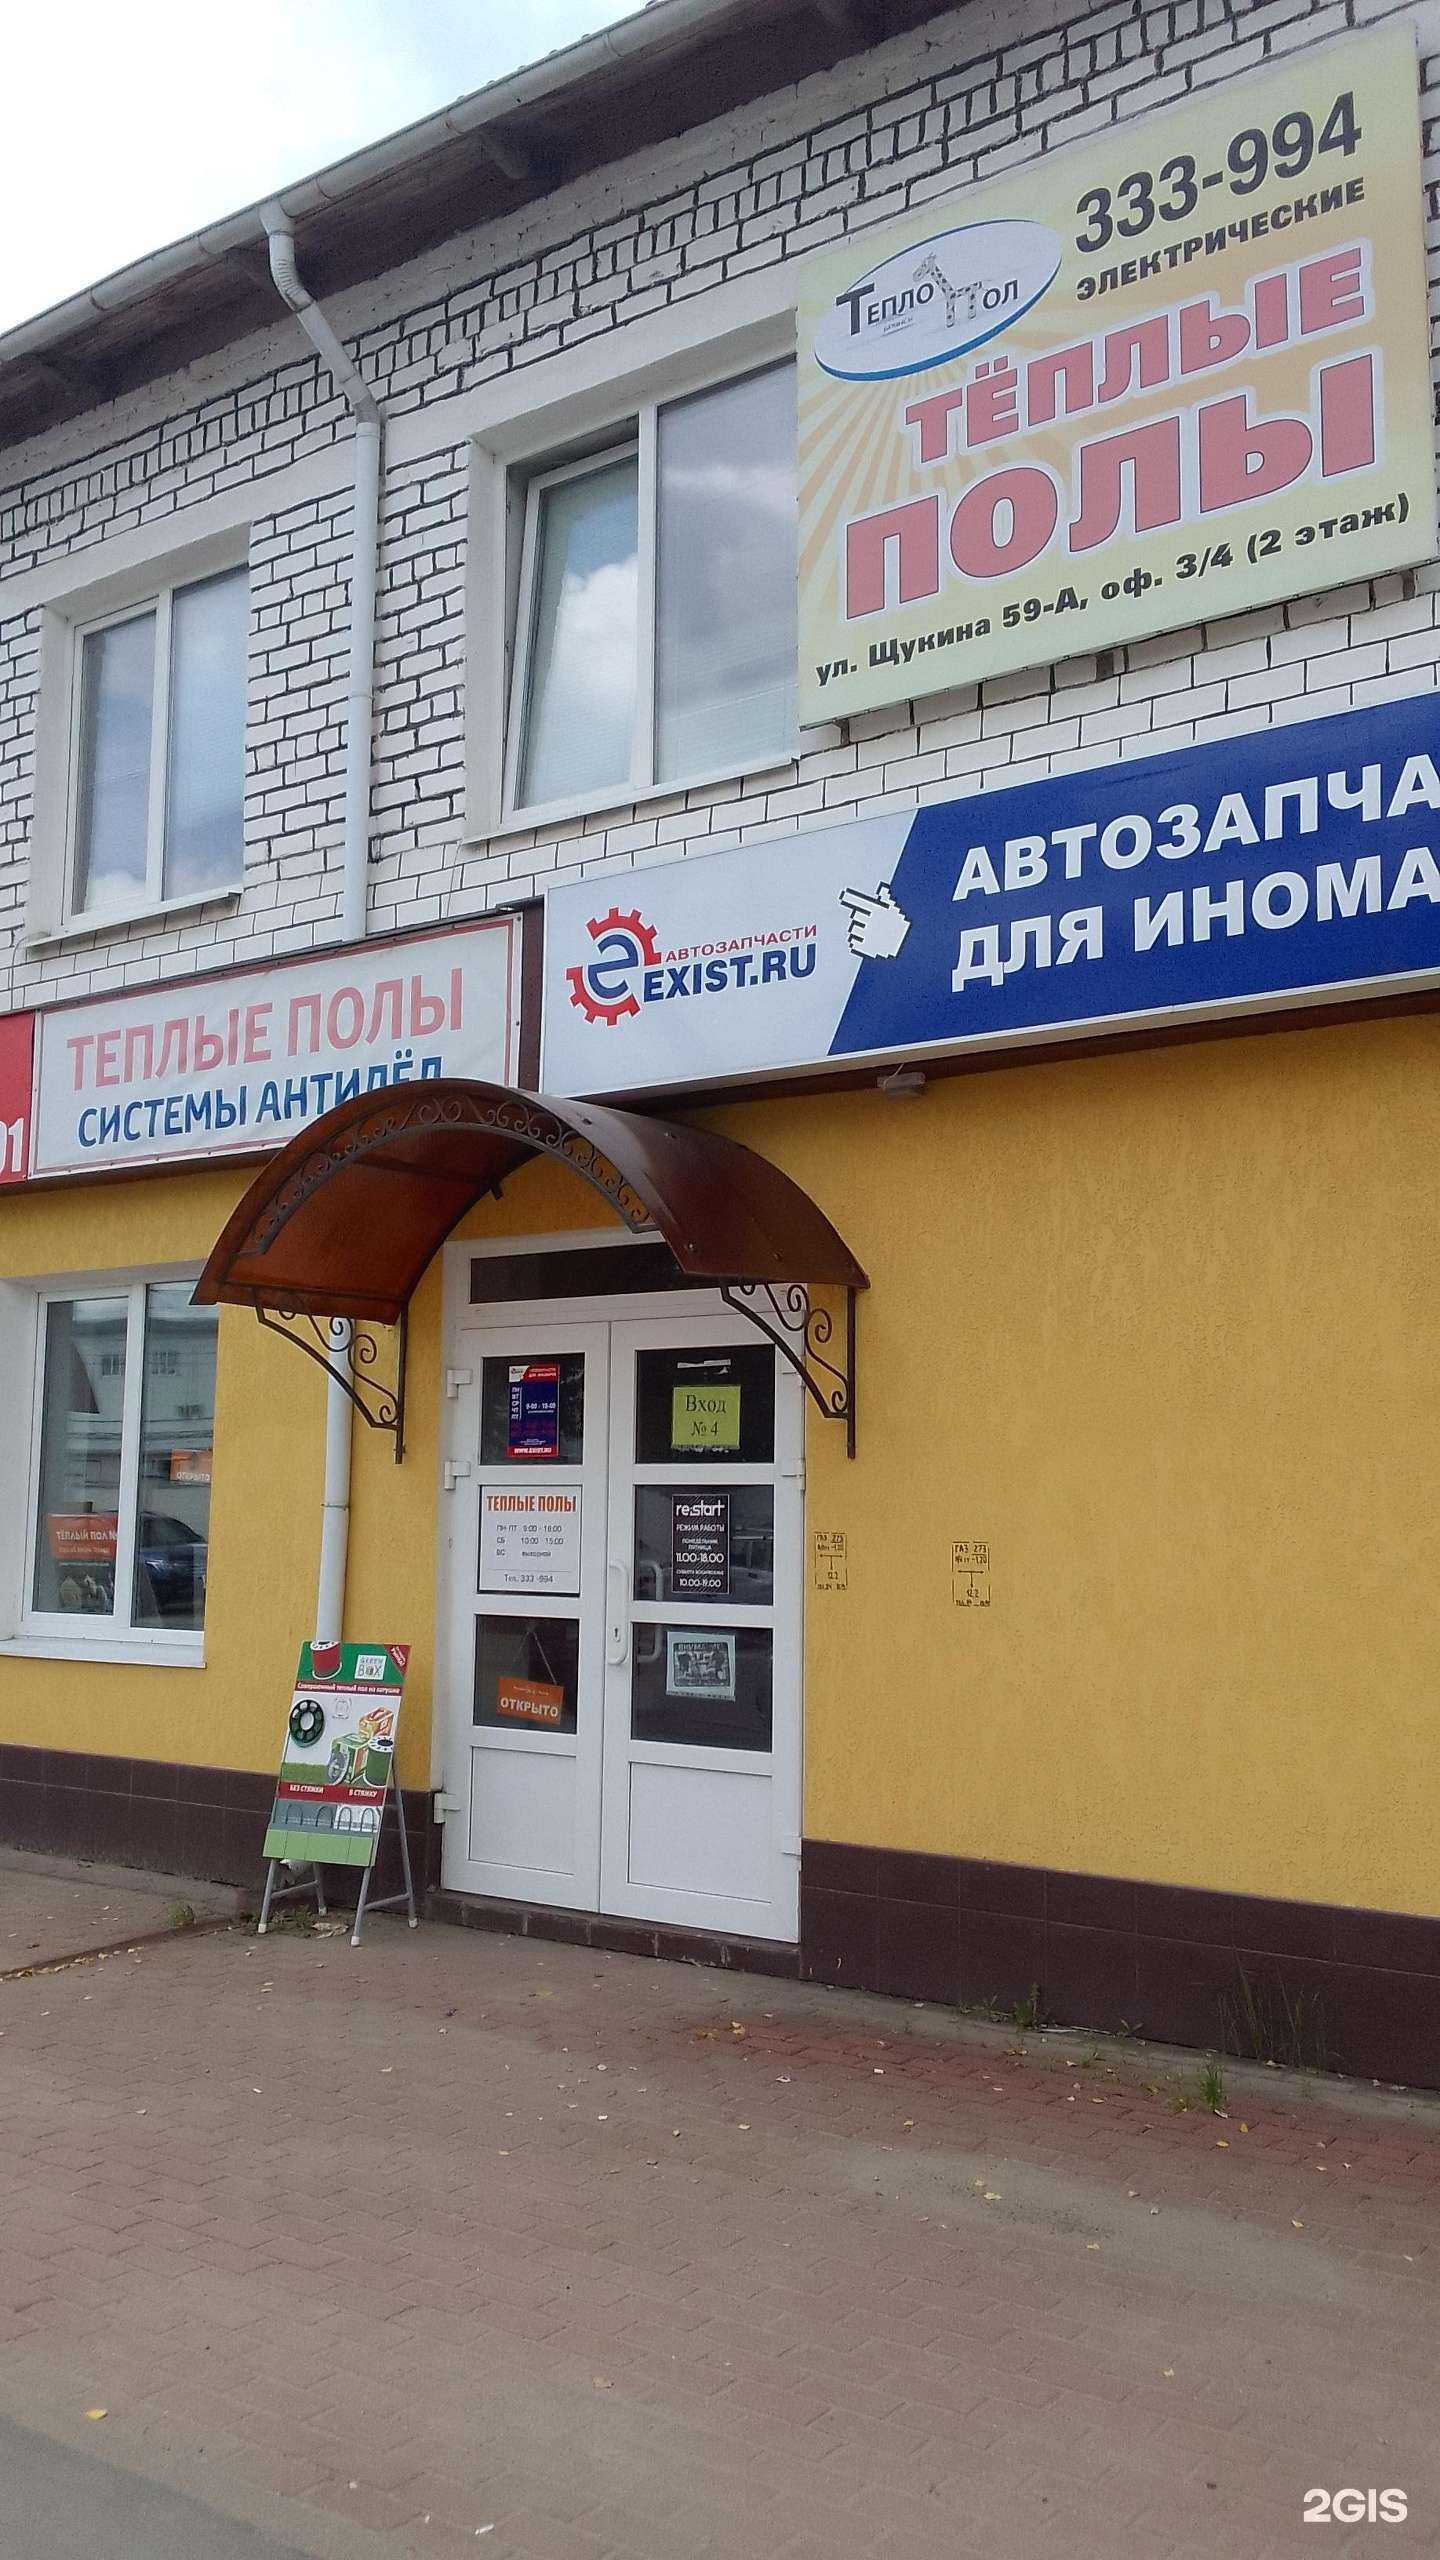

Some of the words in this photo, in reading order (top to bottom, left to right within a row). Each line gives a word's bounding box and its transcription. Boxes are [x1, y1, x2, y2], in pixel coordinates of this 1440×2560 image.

[1075, 91, 1363, 254] 333-994
[1076, 178, 1366, 301] ЭЛЕКТРИЧЕСКИЕ
[905, 247, 1366, 464] ТЁПЛЫЕ
[846, 354, 1375, 620] ПОЛЫ
[816, 655, 858, 687] ул.
[868, 620, 992, 665] Щукина
[1002, 586, 1089, 628] 59-А,
[1101, 567, 1163, 600] оф.
[1175, 543, 1234, 580] 3/4
[1246, 530, 1282, 563] (2
[1295, 493, 1410, 547] этаж)
[665, 924, 817, 963] АВТОЗАПЧАСТИ
[950, 907, 1103, 993] ДЛЯ
[1134, 846, 1440, 952] ИНОМА
[643, 943, 817, 1003] EXIST.RU
[66, 1002, 273, 1091] ТЕПЛЫЕ
[287, 967, 463, 1056] ПОЛЫ
[78, 1085, 248, 1148] СИСТЕМЫ
[686, 1394, 727, 1414] Вход
[691, 1421, 707, 1437] №
[711, 1421, 718, 1437] 4
[487, 1495, 535, 1512] ТЕПЛЫЕ
[538, 1495, 576, 1512] ПОЛЫ
[500, 1696, 559, 1718] ОТКРЫТО
